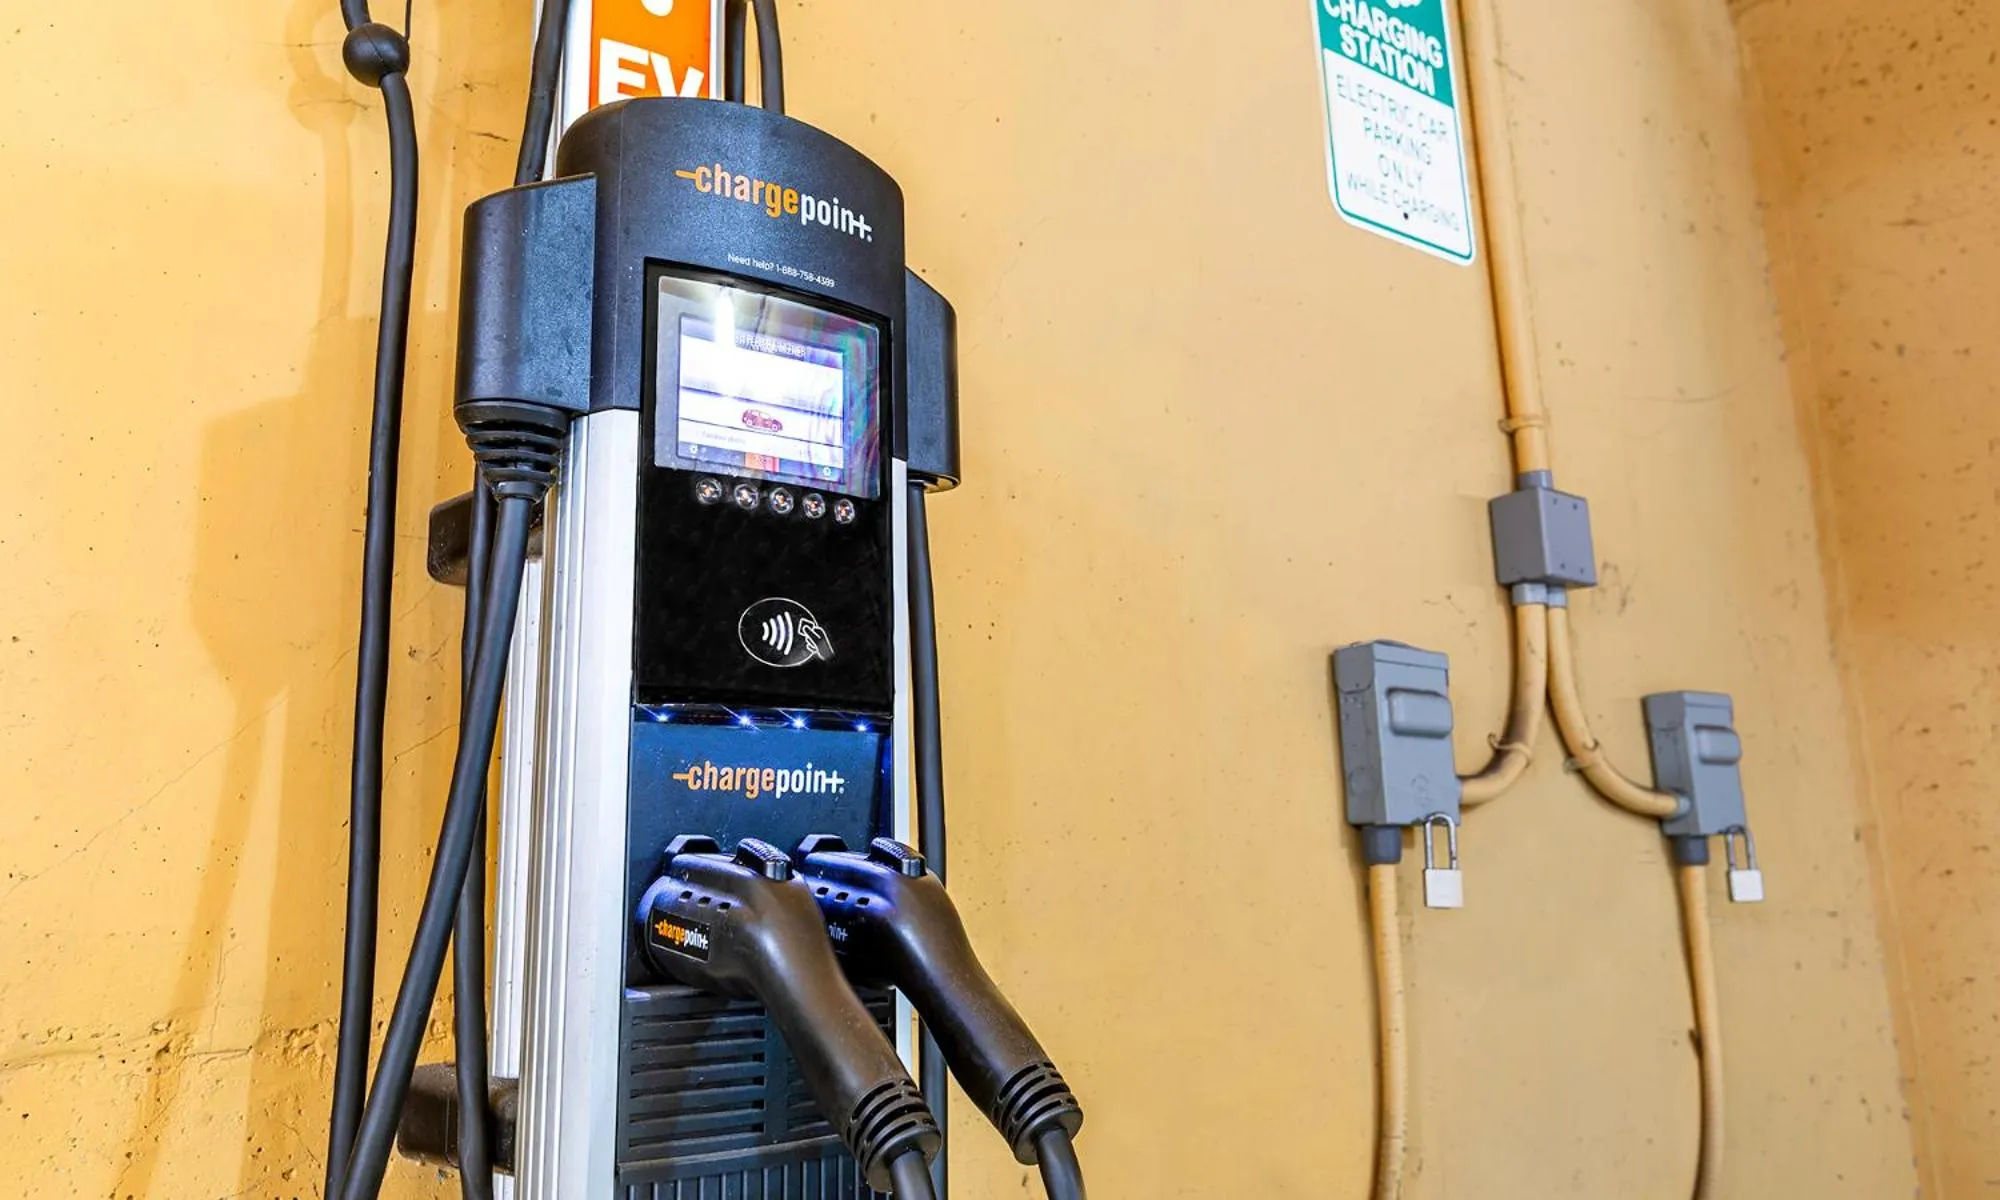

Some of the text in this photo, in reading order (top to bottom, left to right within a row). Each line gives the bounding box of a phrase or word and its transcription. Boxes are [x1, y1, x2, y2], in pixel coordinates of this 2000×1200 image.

[1323, 0, 1443, 68] CHARGING
[1340, 24, 1435, 96] STATION
[599, 37, 704, 105] EV
[1336, 73, 1449, 143] ELECTRIC CAR
[1363, 116, 1432, 165] PARKING
[1378, 153, 1425, 192] ONLY
[674, 162, 873, 241] chargepoint
[1347, 171, 1460, 232] WHILE CHARGING
[727, 253, 751, 266] Need
[752, 257, 774, 271] help?
[673, 760, 845, 799] chargepoint
